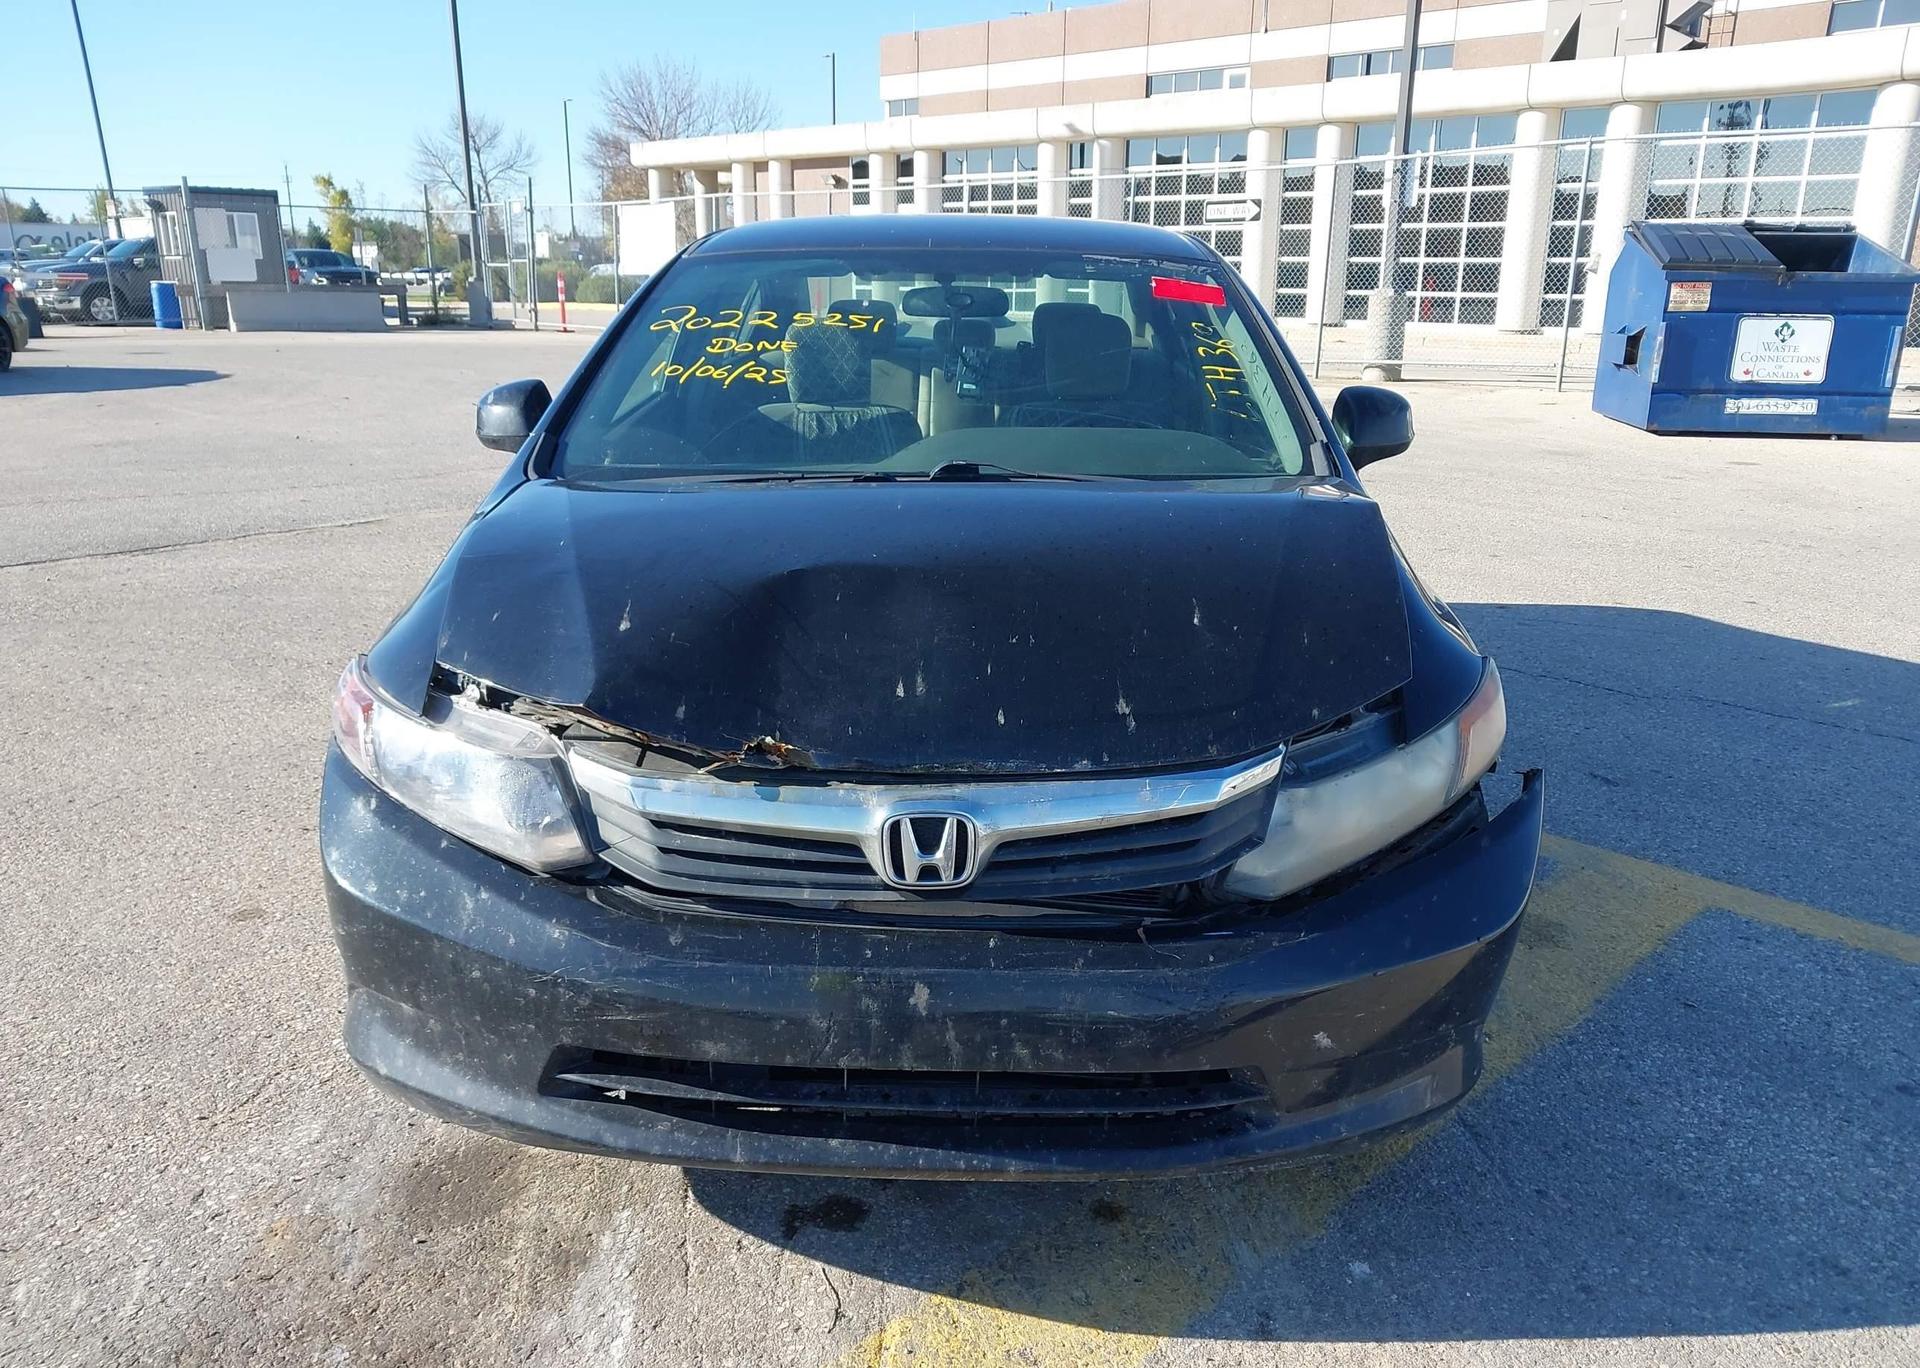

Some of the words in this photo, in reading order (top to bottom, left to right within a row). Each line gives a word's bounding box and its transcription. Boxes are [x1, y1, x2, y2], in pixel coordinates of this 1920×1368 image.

[1210, 207, 1227, 216] ONE
[1232, 206, 1251, 215] WAY
[706, 337, 798, 355] DONE
[1762, 342, 1800, 353] WASTE
[1740, 352, 1821, 363] CONNECTIONS
[651, 357, 790, 389] 10/06/25
[1756, 368, 1800, 379] CANADA
